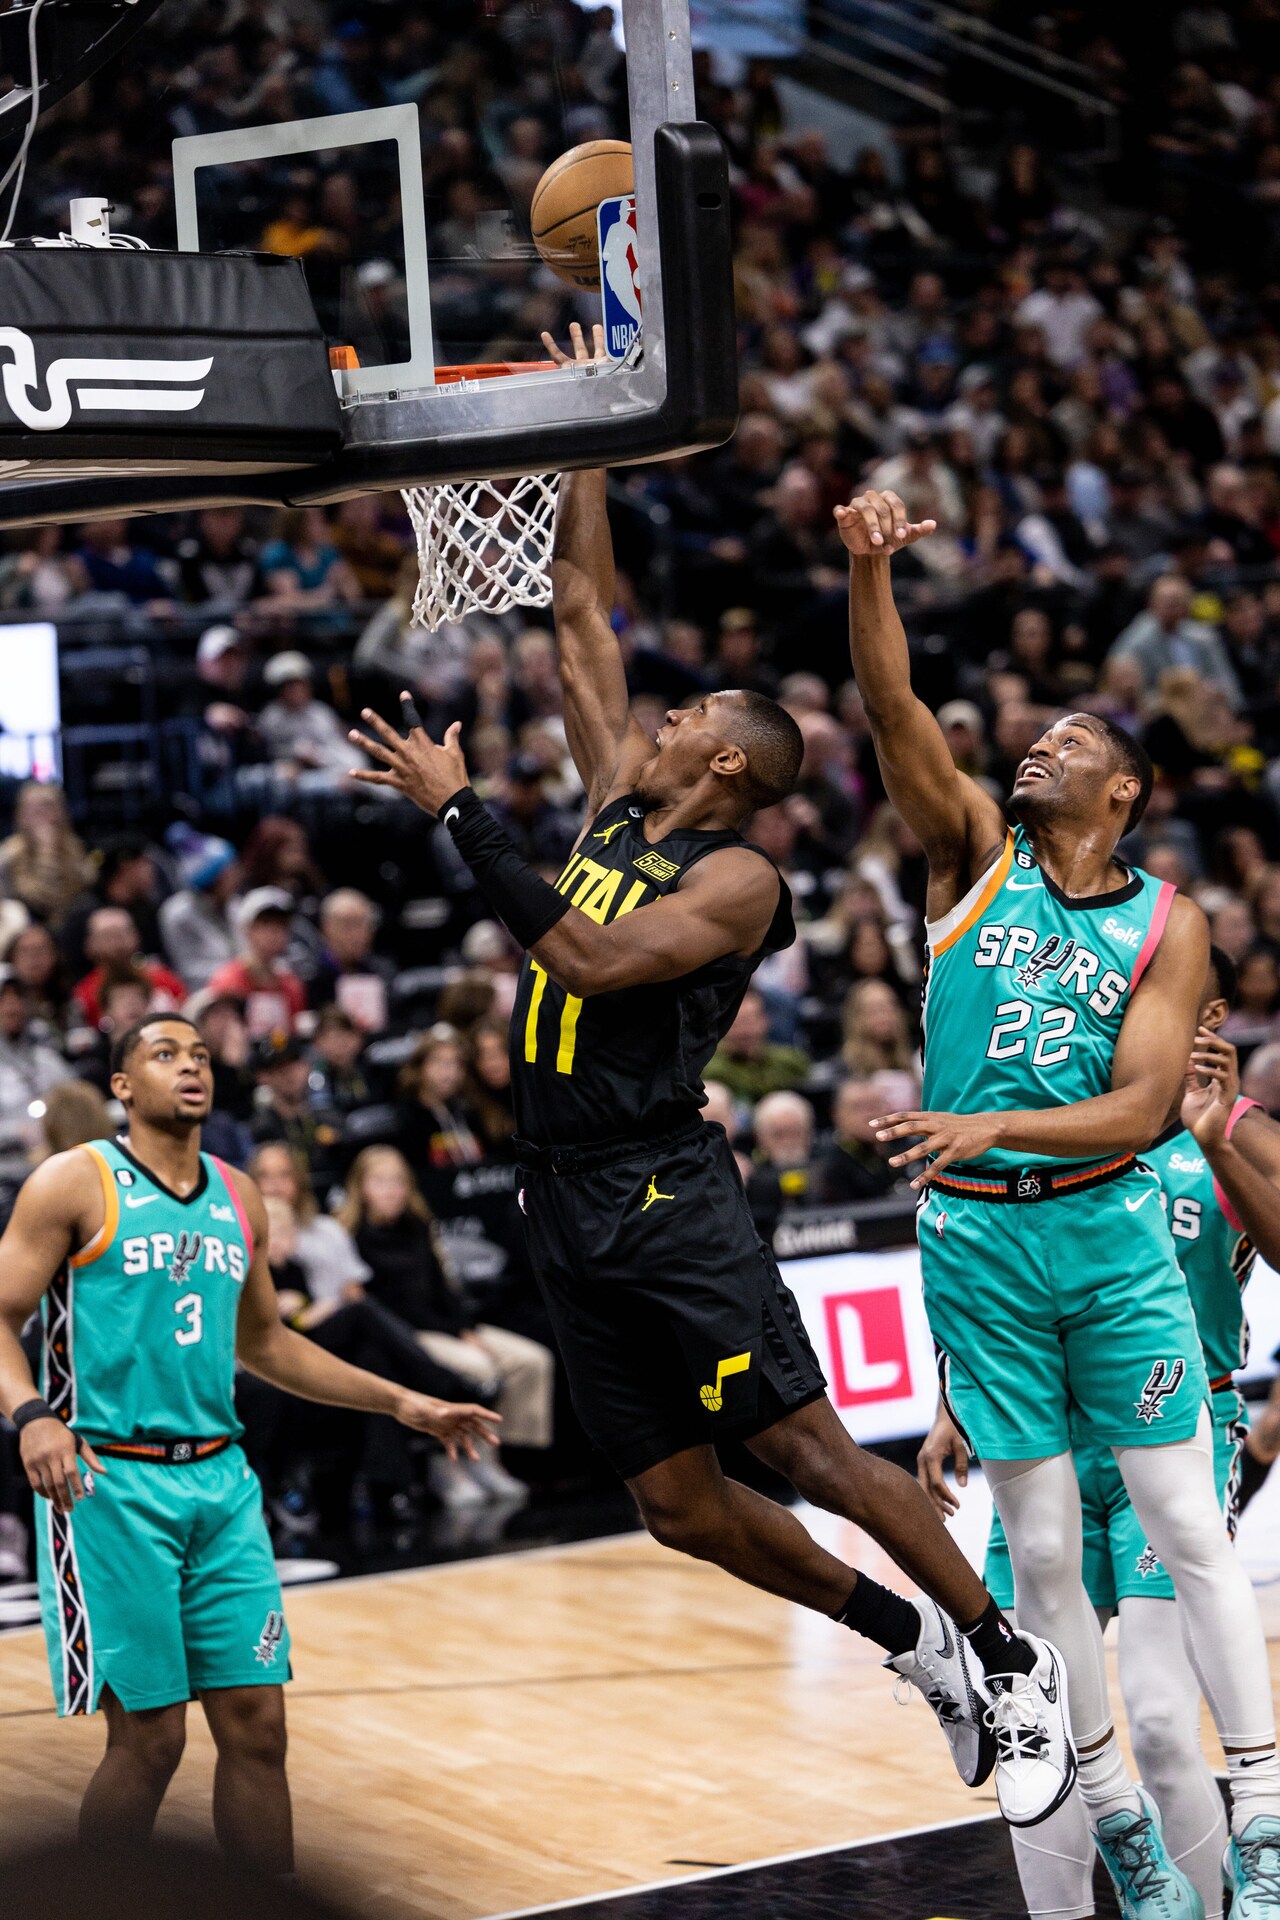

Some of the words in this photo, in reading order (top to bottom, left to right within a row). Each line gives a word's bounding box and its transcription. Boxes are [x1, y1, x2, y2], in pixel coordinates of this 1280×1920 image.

[1016, 852, 1032, 868] 6
[973, 925, 1131, 1017] SPURS
[985, 999, 1078, 1067] 22
[122, 1229, 245, 1286] SPURS
[174, 1292, 203, 1346] 3
[836, 1303, 902, 1393] L
